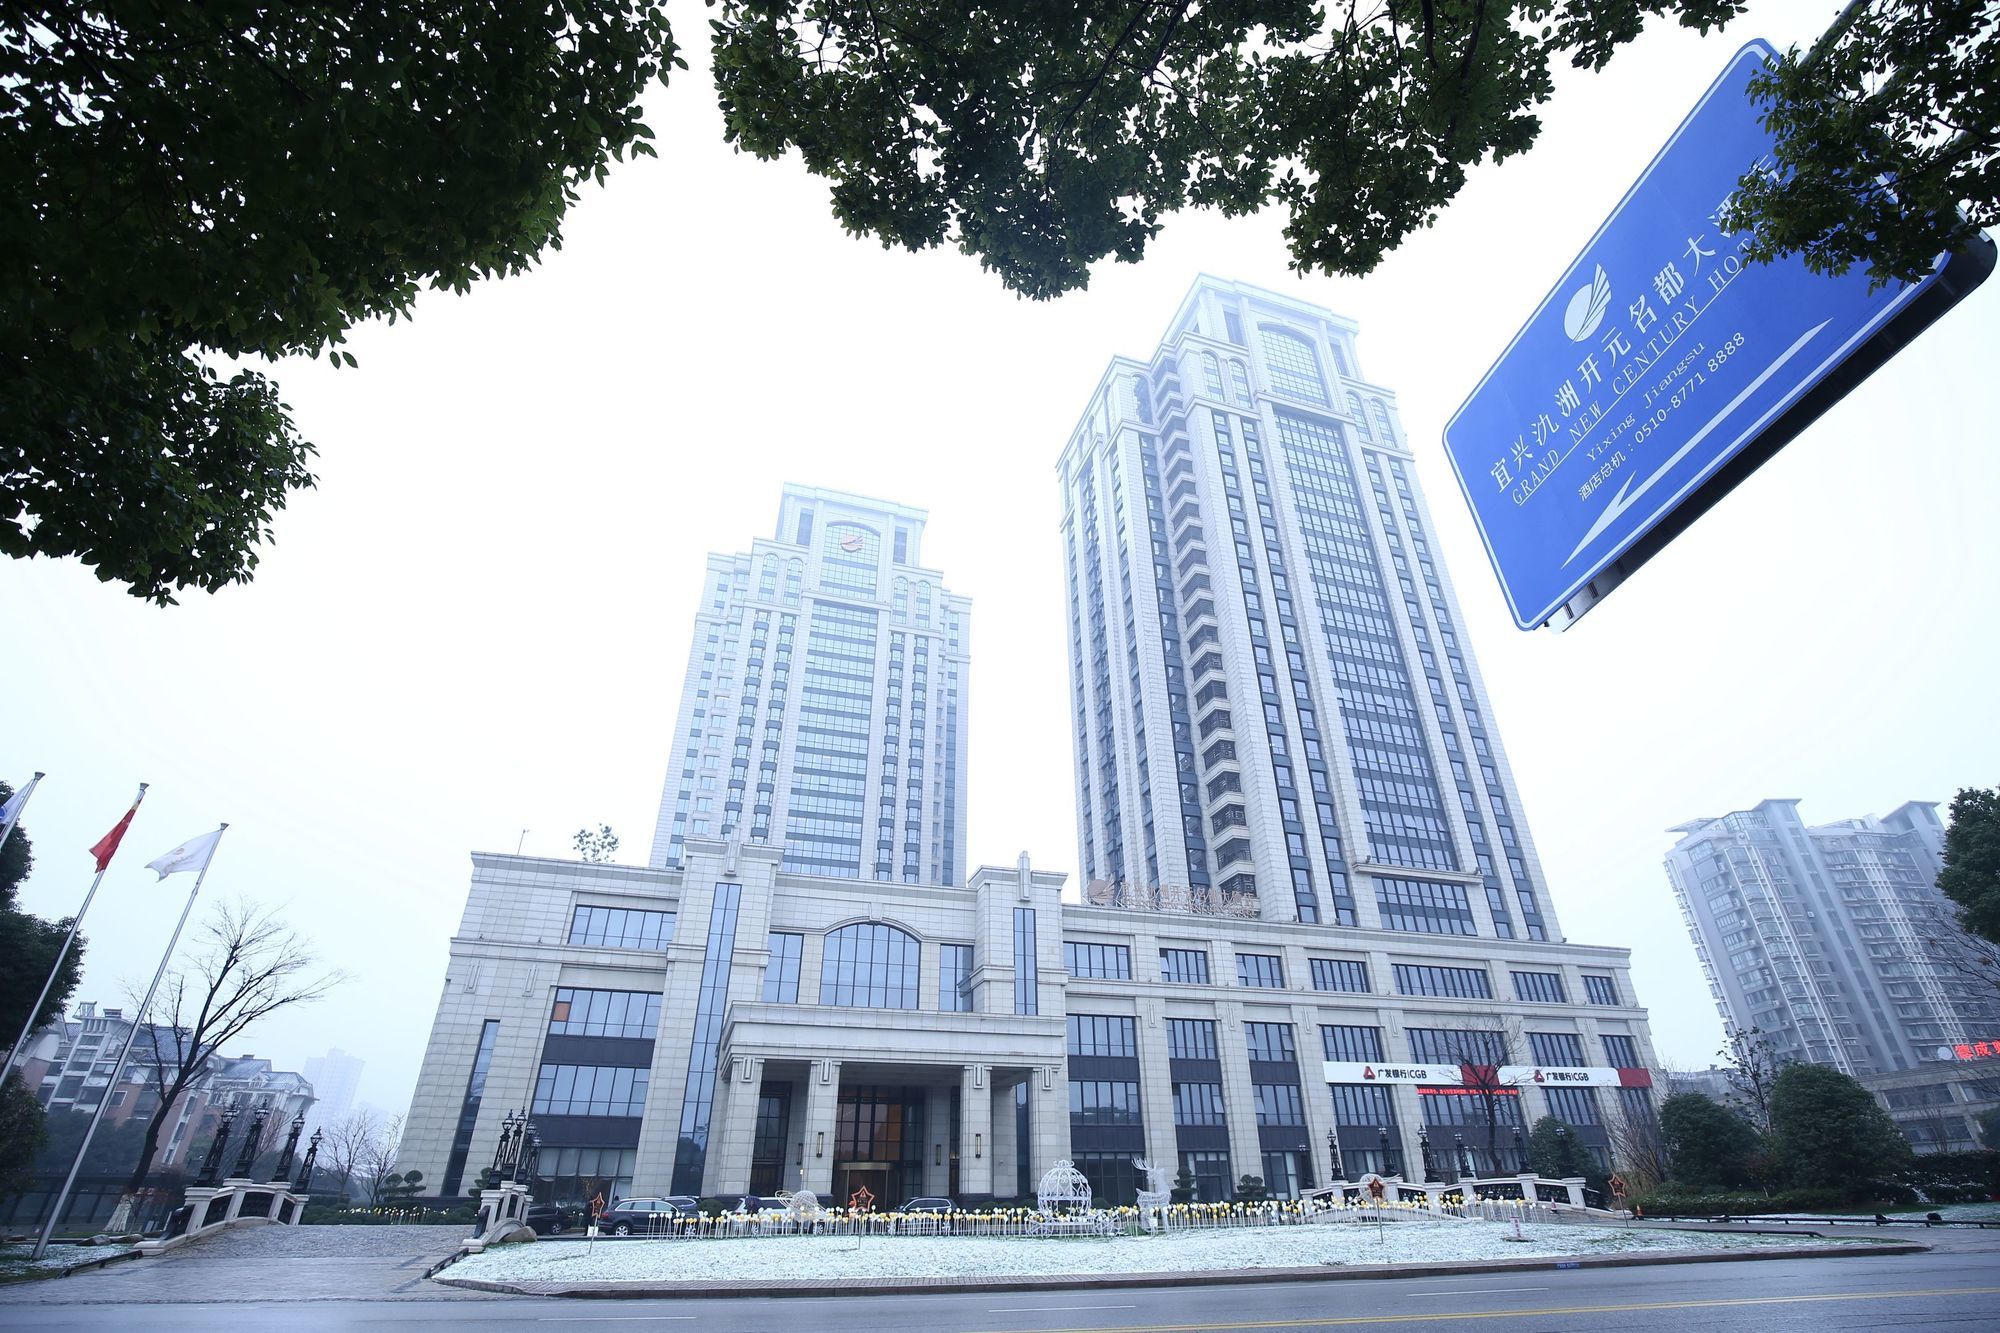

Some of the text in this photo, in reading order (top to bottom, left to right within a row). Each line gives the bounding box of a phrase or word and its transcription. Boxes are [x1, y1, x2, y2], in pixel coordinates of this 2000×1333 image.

[1512, 221, 1764, 505] GRAND NEW CENTURY HOT
[1586, 342, 1705, 462] Yixing Jiangsu
[1707, 332, 1745, 373] 8888
